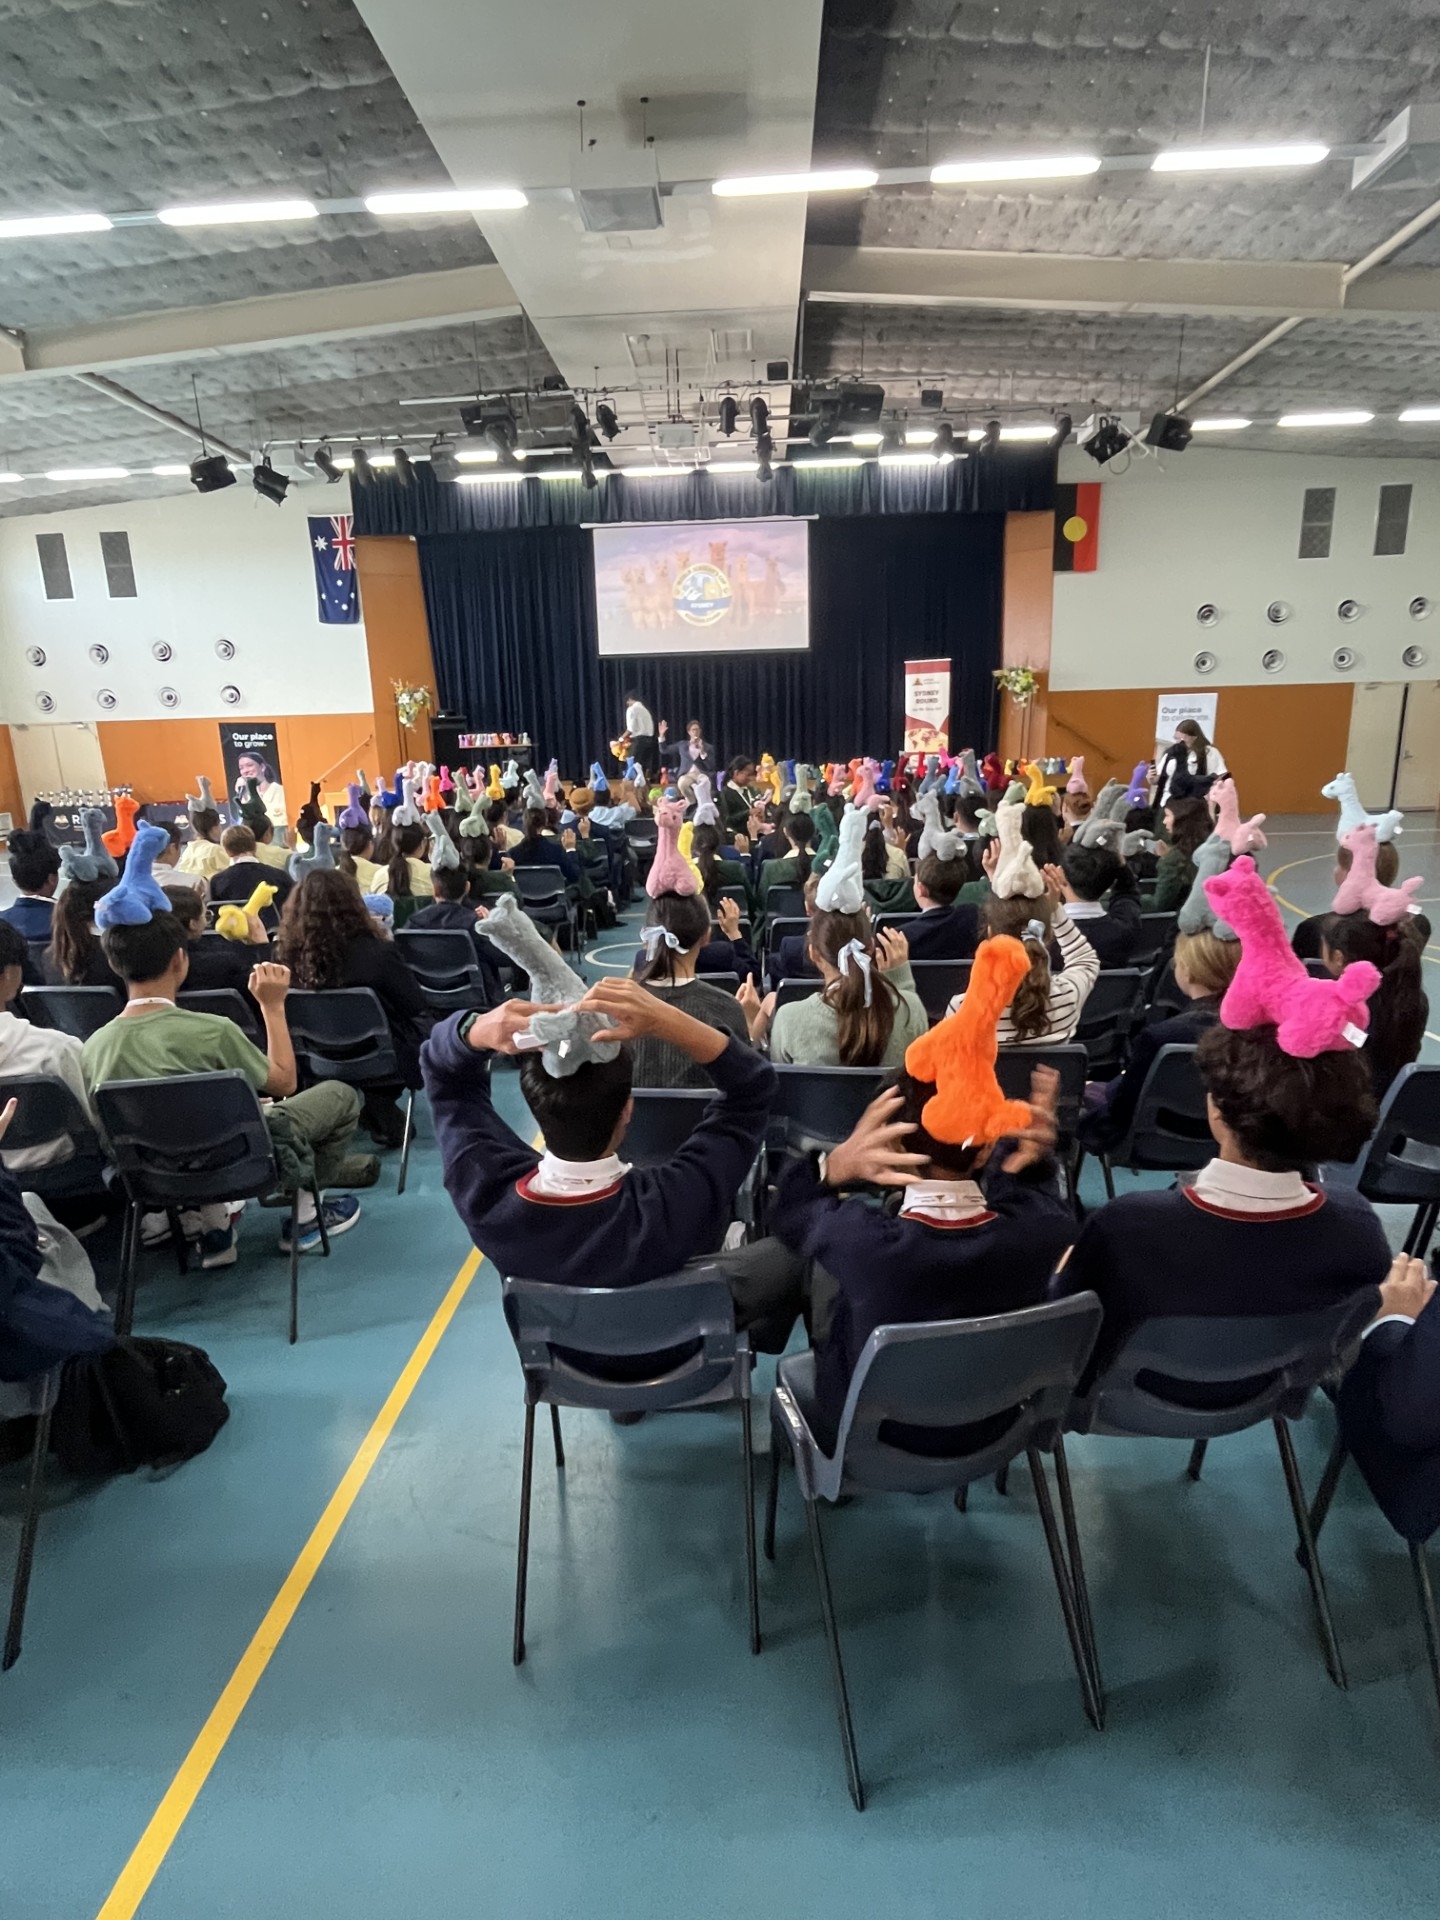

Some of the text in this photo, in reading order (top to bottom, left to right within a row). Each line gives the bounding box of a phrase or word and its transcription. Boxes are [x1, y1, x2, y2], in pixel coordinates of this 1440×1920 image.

[1161, 706, 1202, 715] Our place
[232, 732, 273, 742] Our place
[244, 741, 267, 749] grow.
